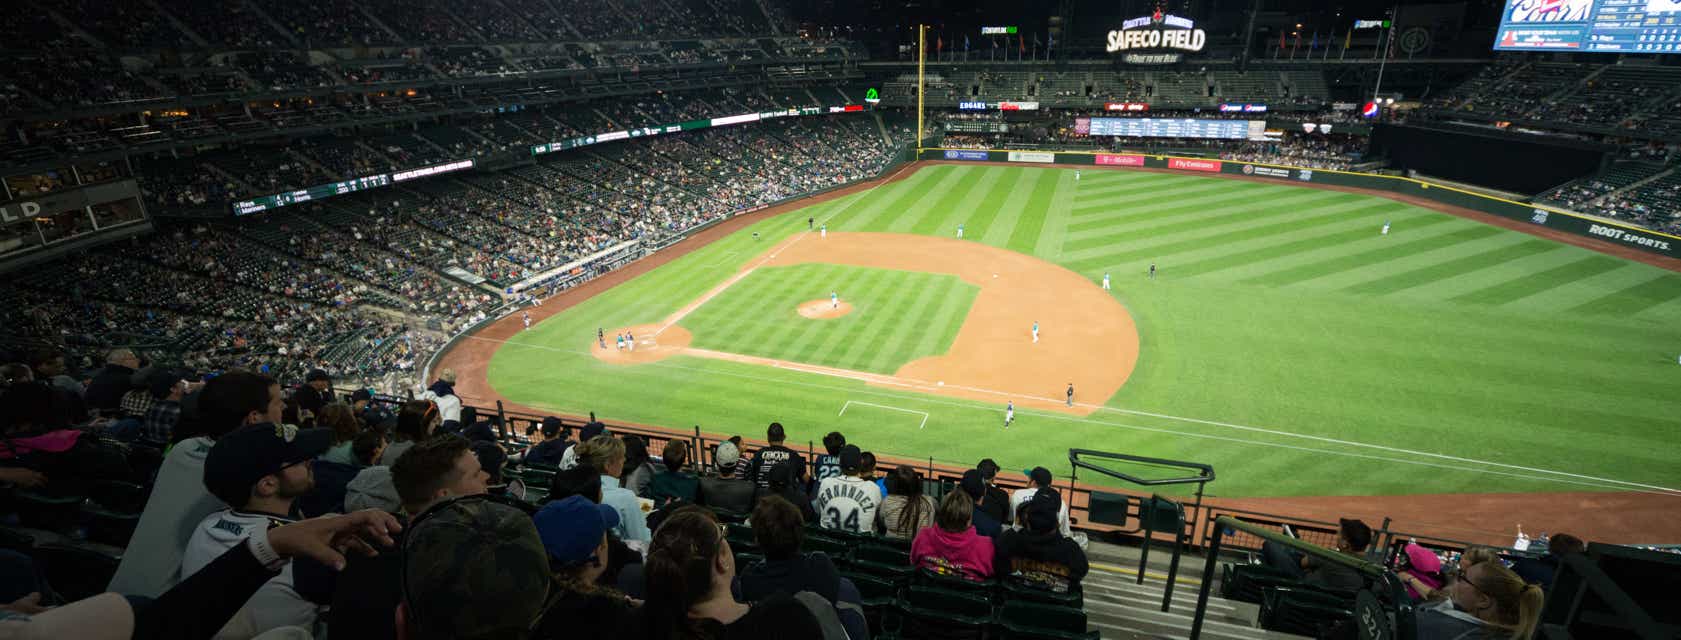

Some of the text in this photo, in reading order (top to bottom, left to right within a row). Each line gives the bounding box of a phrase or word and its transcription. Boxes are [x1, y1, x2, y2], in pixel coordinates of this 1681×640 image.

[1106, 29, 1206, 52] SAFECO FIELD
[1175, 160, 1187, 168] Fly
[1588, 223, 1625, 239] ROOT
[826, 506, 860, 531] 34
